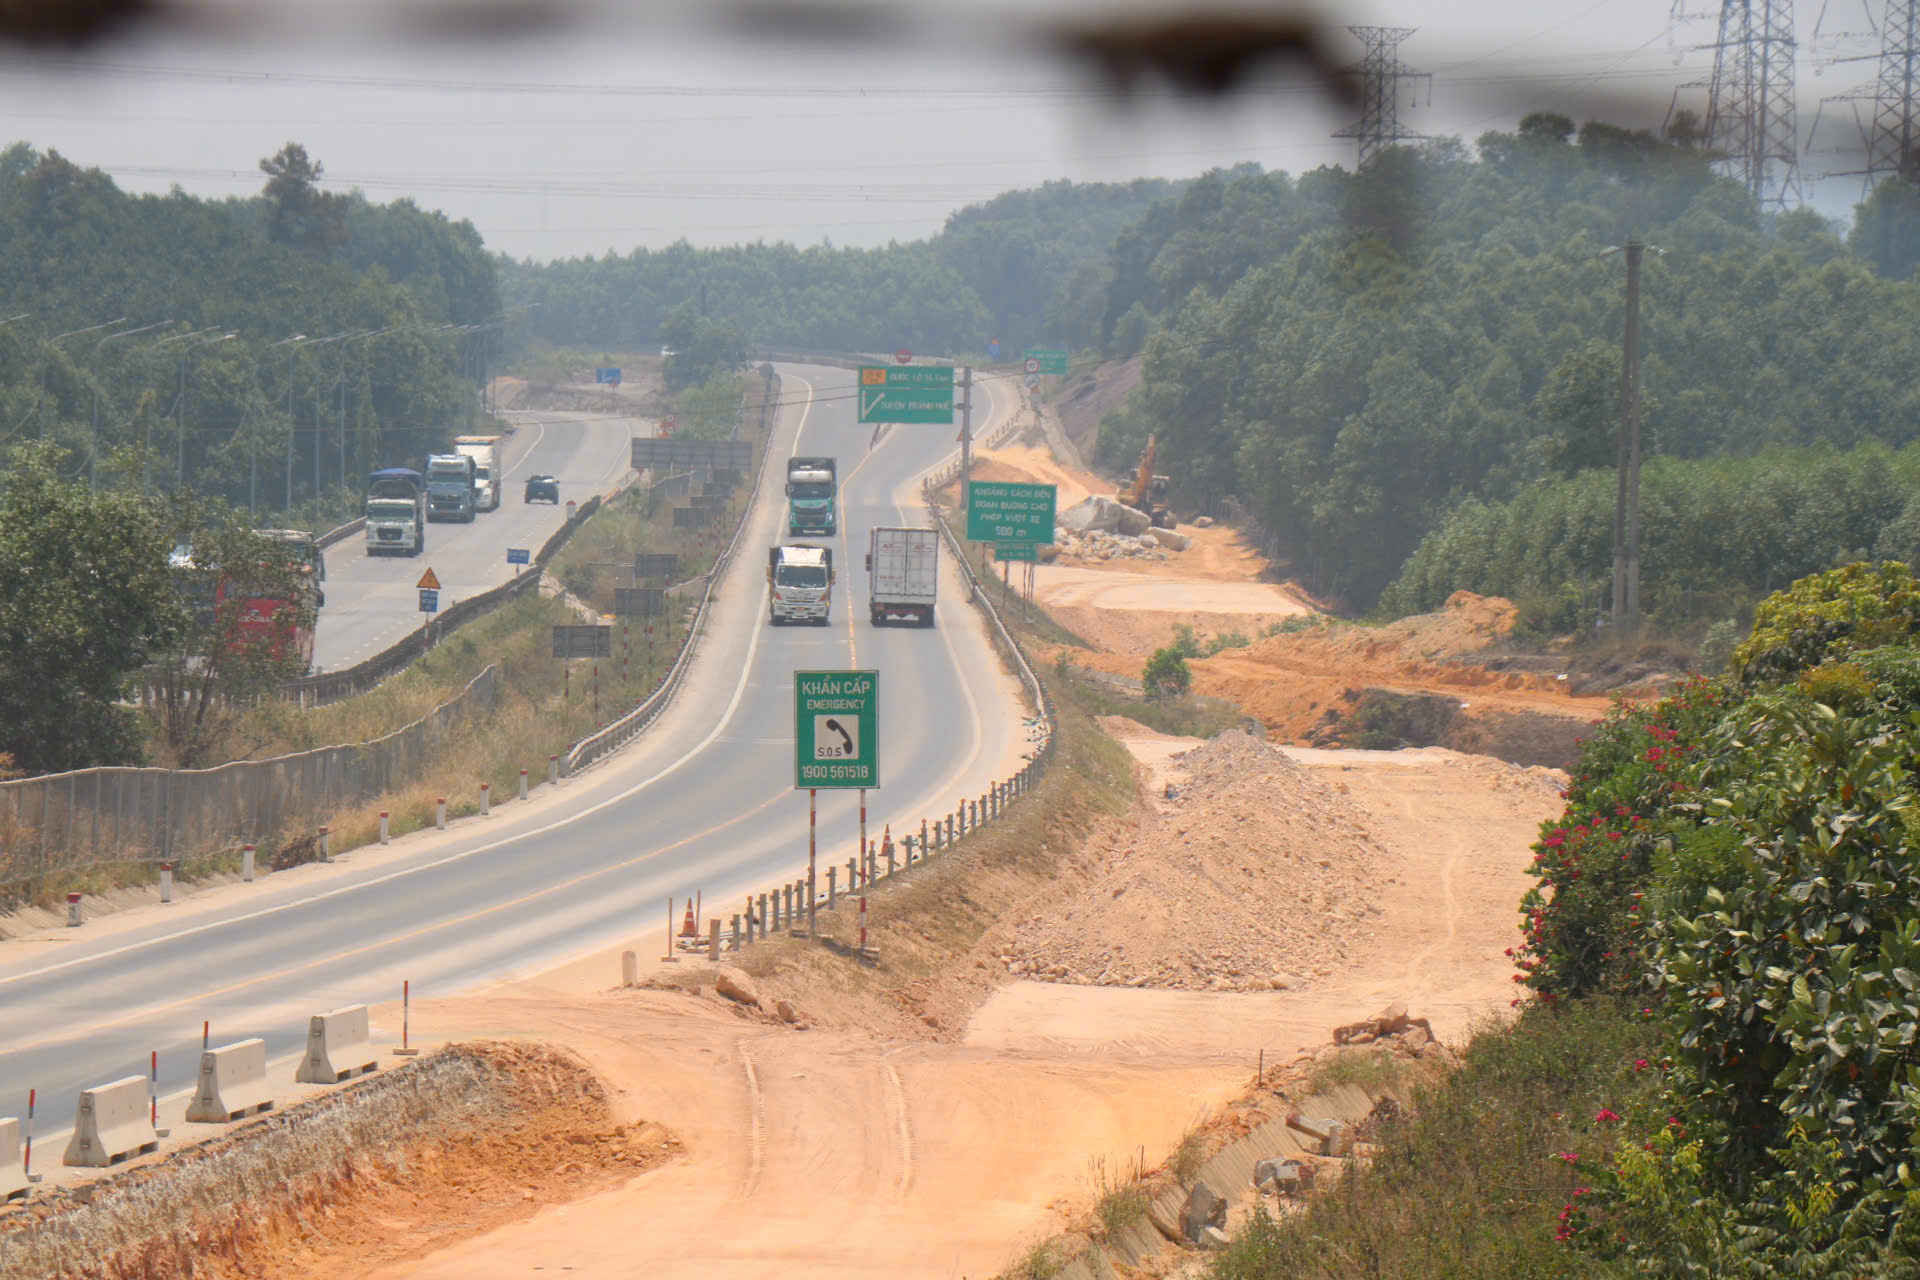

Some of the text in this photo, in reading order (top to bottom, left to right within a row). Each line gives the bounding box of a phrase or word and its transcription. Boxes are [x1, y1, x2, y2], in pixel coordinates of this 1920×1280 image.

[995, 526, 1013, 536] 500
[802, 675, 870, 695] KHẨN CẤP
[807, 699, 865, 709] EMERGENCY
[802, 765, 869, 778] 1900 561518
